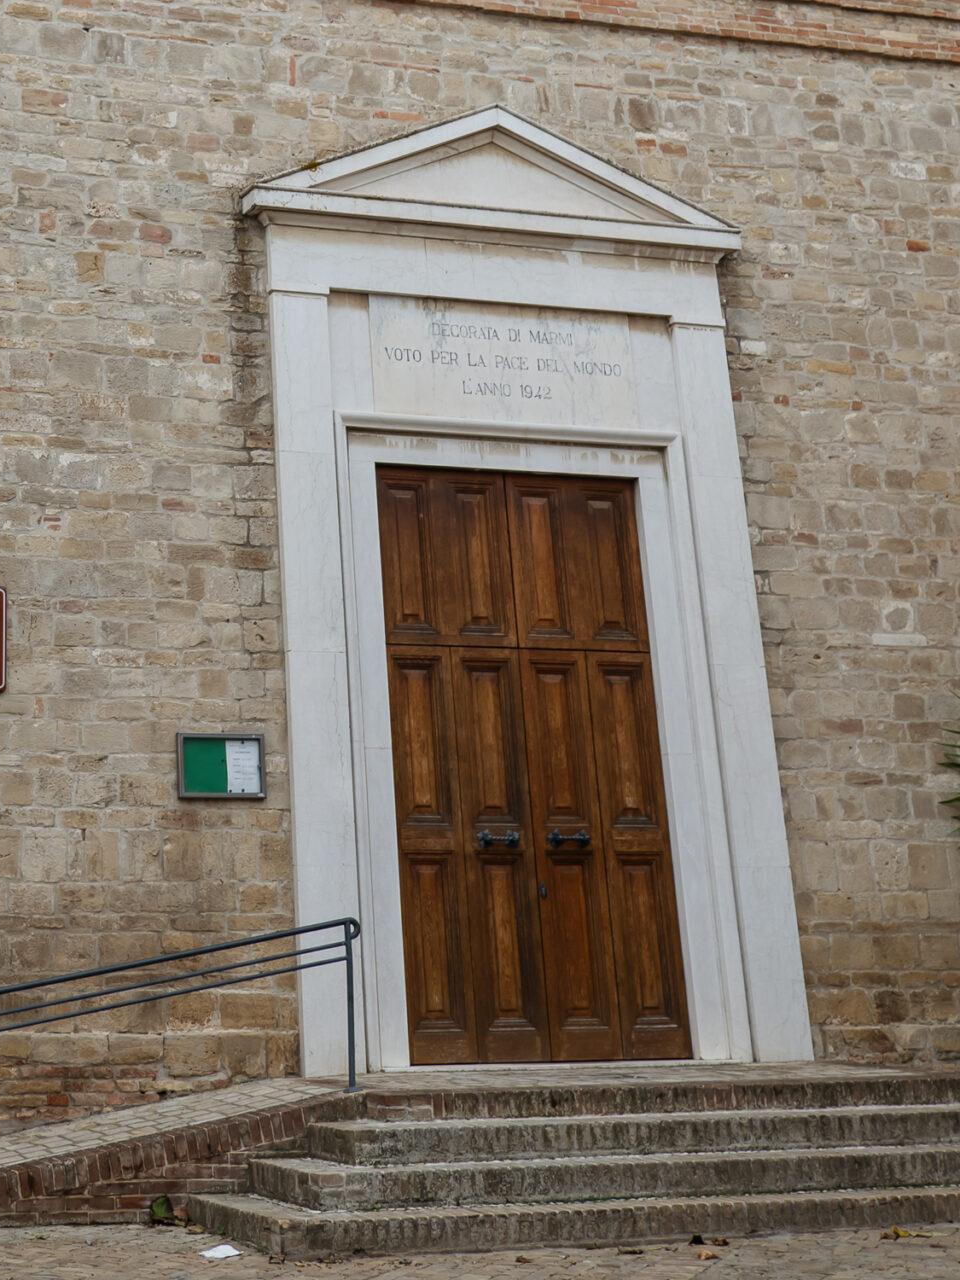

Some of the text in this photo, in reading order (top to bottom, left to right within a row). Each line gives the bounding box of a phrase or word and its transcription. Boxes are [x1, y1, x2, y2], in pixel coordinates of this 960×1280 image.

[431, 322, 573, 346] DECORATA DI MARMI
[384, 346, 622, 377] VOTO PER LA PACE DEL MONDO
[519, 383, 553, 400] 1942
